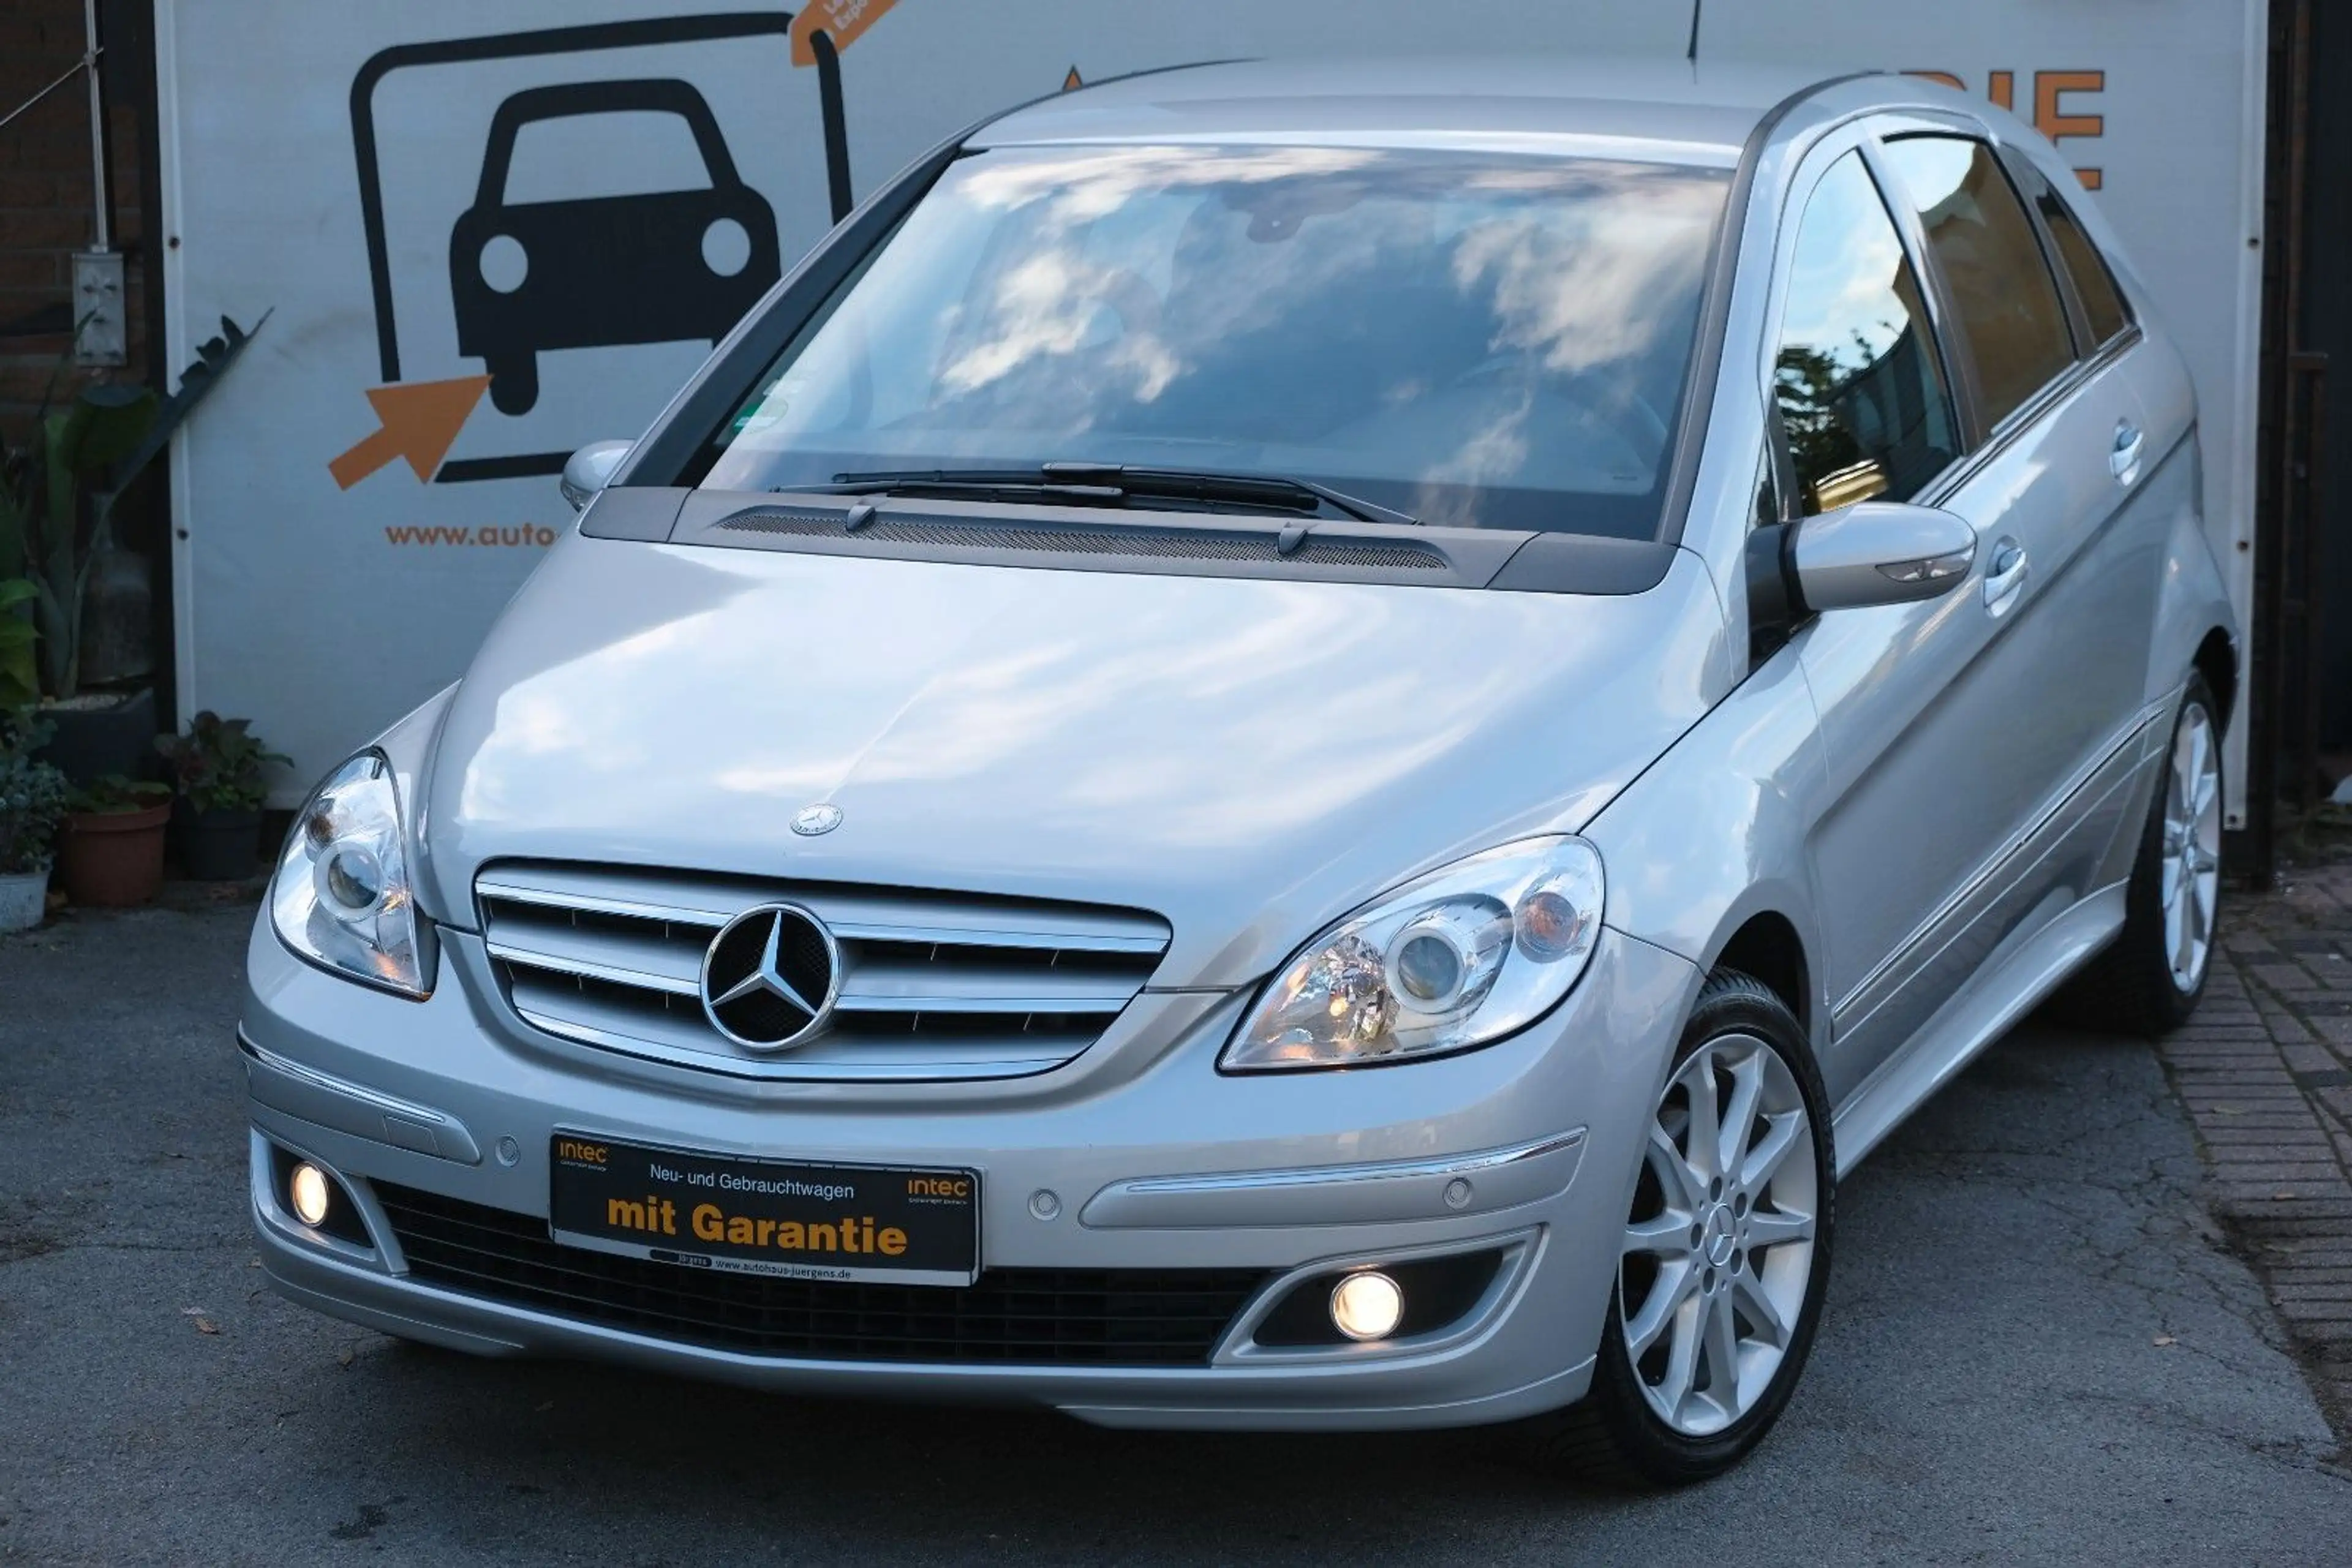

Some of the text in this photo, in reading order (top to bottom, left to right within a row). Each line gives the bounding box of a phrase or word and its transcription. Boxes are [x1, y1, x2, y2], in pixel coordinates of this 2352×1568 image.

[650, 1164, 854, 1200] Neu- und Gebrauchtwagen
[608, 1195, 907, 1256] mit Garantie
[715, 1260, 851, 1280] www.autohaus-juergens.de
